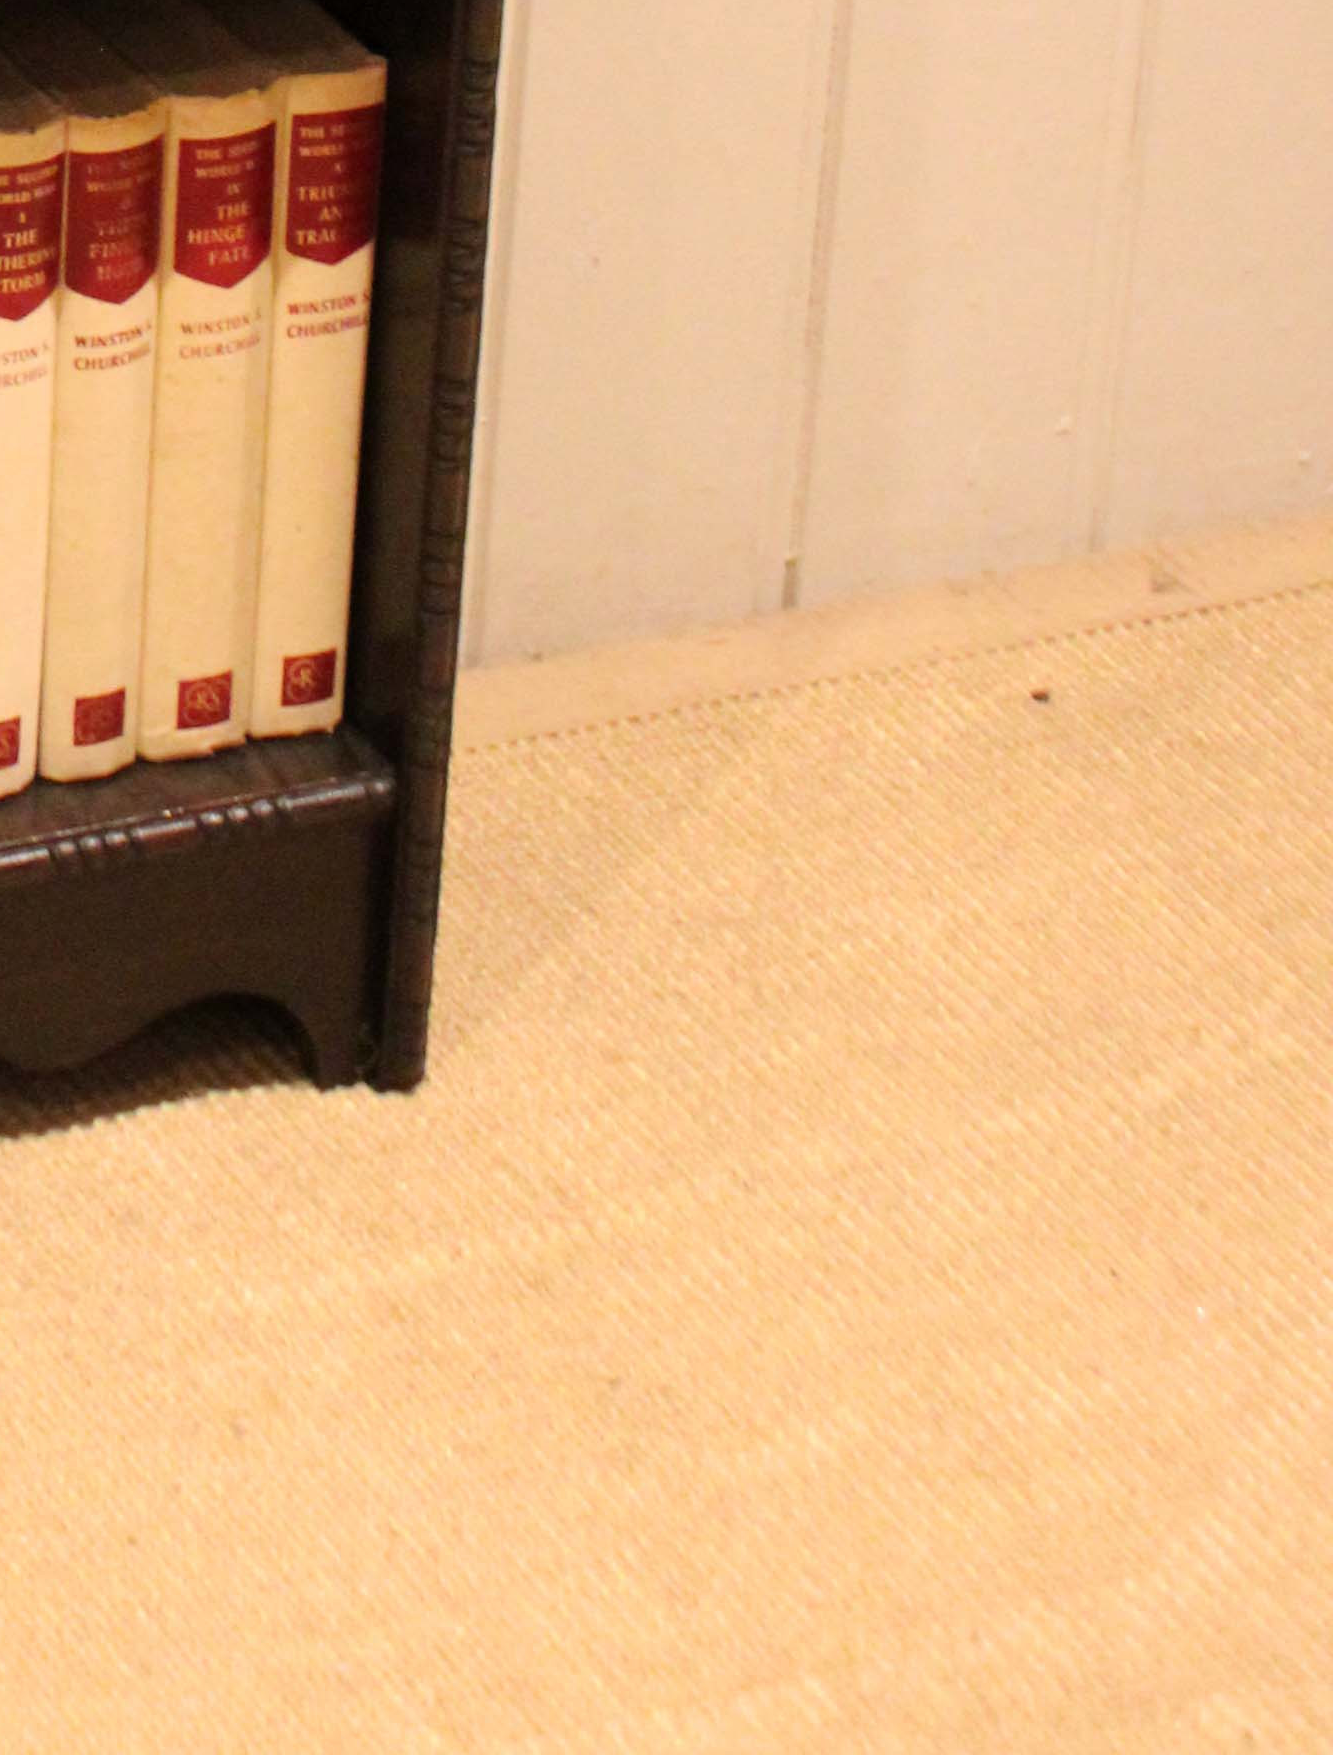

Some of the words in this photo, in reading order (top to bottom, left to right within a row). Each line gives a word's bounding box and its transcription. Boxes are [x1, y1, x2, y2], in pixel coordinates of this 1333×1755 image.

[217, 201, 250, 221] THE
[3, 228, 39, 248] THE
[188, 225, 248, 245] HINGE
[287, 295, 358, 317] WINSTON
[180, 316, 251, 336] WINSTON
[75, 325, 144, 348] WINSTON
